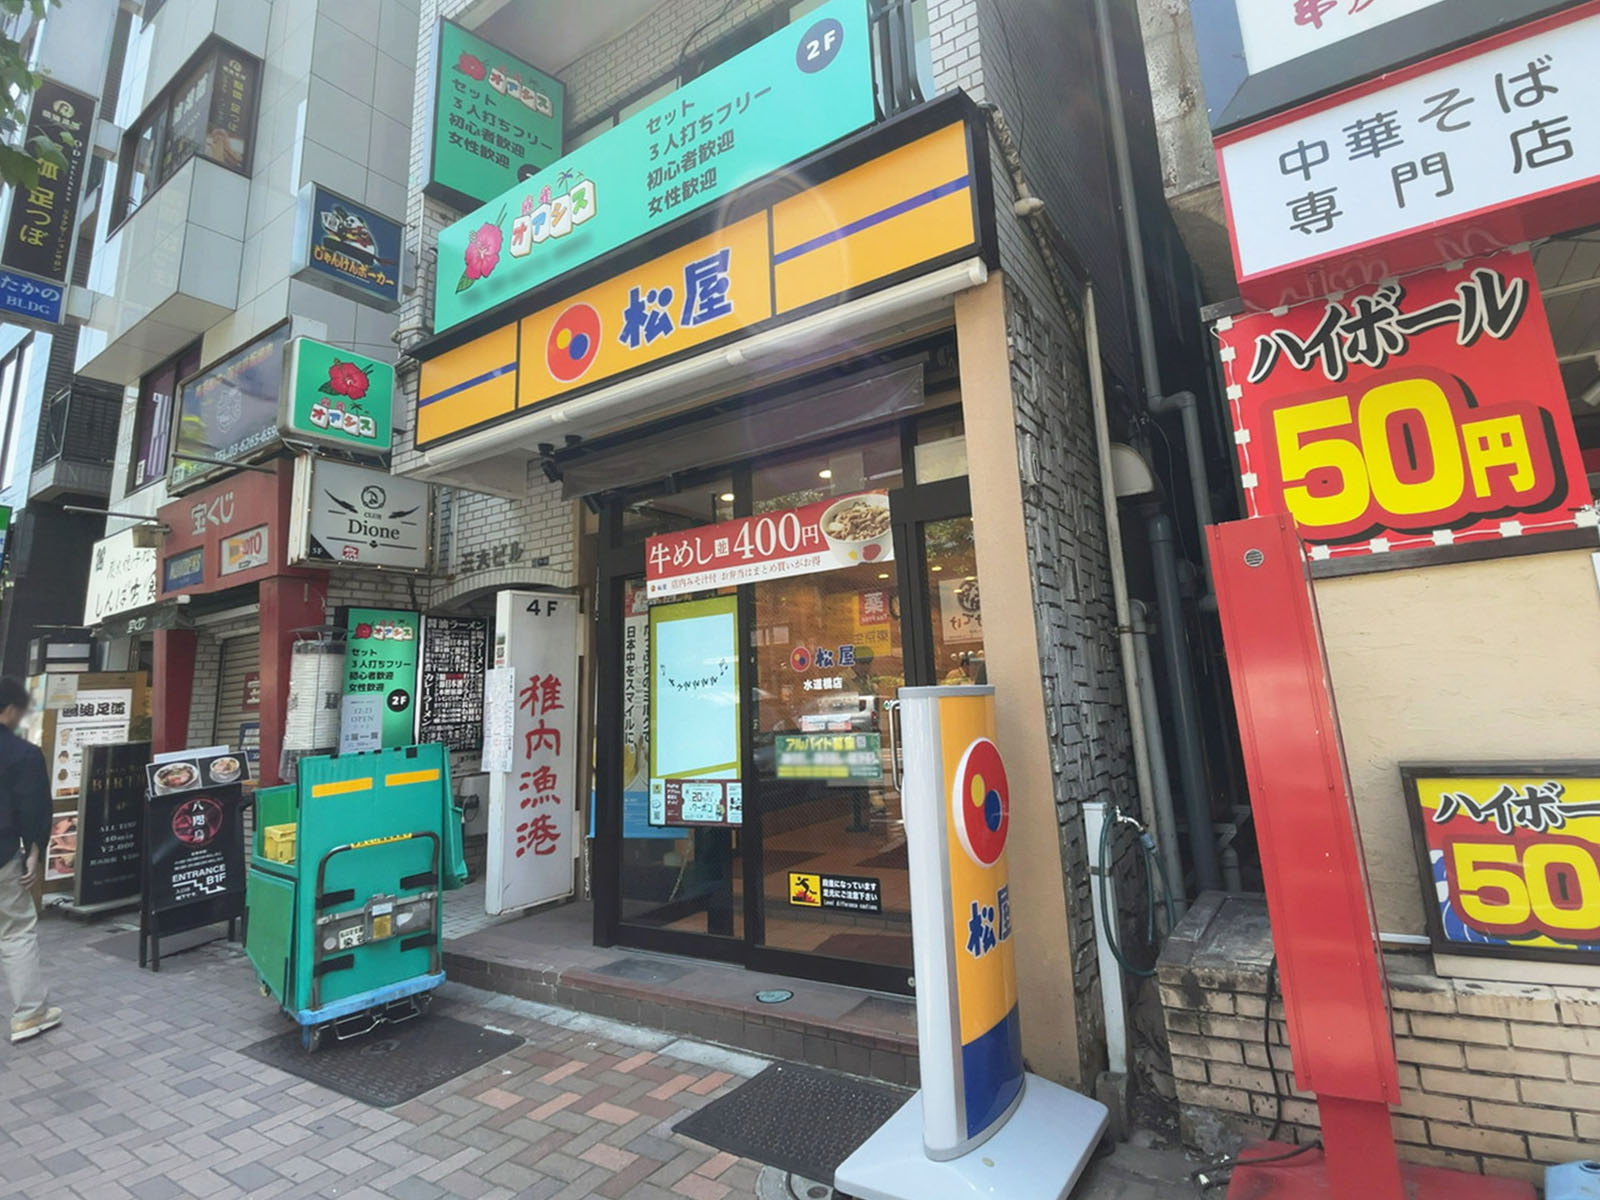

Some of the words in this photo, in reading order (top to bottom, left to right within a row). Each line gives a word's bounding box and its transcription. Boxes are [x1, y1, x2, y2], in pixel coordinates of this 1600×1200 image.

[805, 30, 837, 61] 2F
[452, 78, 497, 106] セット
[489, 69, 554, 115] オアシス
[448, 112, 526, 159] 初心者歓迎
[453, 96, 552, 150] 3人打ちフリー
[646, 98, 696, 135] セット
[649, 86, 772, 161] 3人打ちフリー
[1279, 55, 1559, 181] 中華そば
[448, 131, 511, 169] 女性歓迎
[646, 128, 735, 191] 初心者歓迎
[647, 166, 718, 219] 女性歓迎
[1286, 115, 1574, 235] 専門店
[511, 184, 592, 252] オアシス
[313, 244, 395, 286] じゃんけんポーカー
[0, 275, 61, 302] たかの
[6, 294, 51, 316] BLDG
[617, 247, 734, 352] 松屋
[1246, 266, 1530, 384] ハイボール
[309, 405, 374, 435] オアシス
[1272, 377, 1537, 527] 50円
[191, 491, 235, 536] 宝くじ
[347, 518, 400, 541] Dione
[648, 536, 714, 575] 牛めし
[732, 512, 820, 560] 400円
[720, 555, 822, 582] お弁当はまとめ買いがお得
[526, 599, 558, 617] 4F
[374, 625, 413, 640] オアシス
[351, 648, 378, 657] セット
[351, 660, 411, 669] 3人打ちフリー
[813, 644, 856, 669] 松屋
[348, 671, 394, 681] 初心者歓迎
[348, 683, 385, 693] 女性歓迎
[802, 676, 843, 691] 水道橋店
[391, 695, 408, 706] 2F
[421, 672, 434, 726] カレーラーメン
[516, 672, 566, 859] 稚内漁港
[1432, 780, 1600, 835] ハイボー
[172, 863, 226, 883] ENTRANCE
[205, 872, 227, 886] B1F
[1451, 842, 1600, 931] 50
